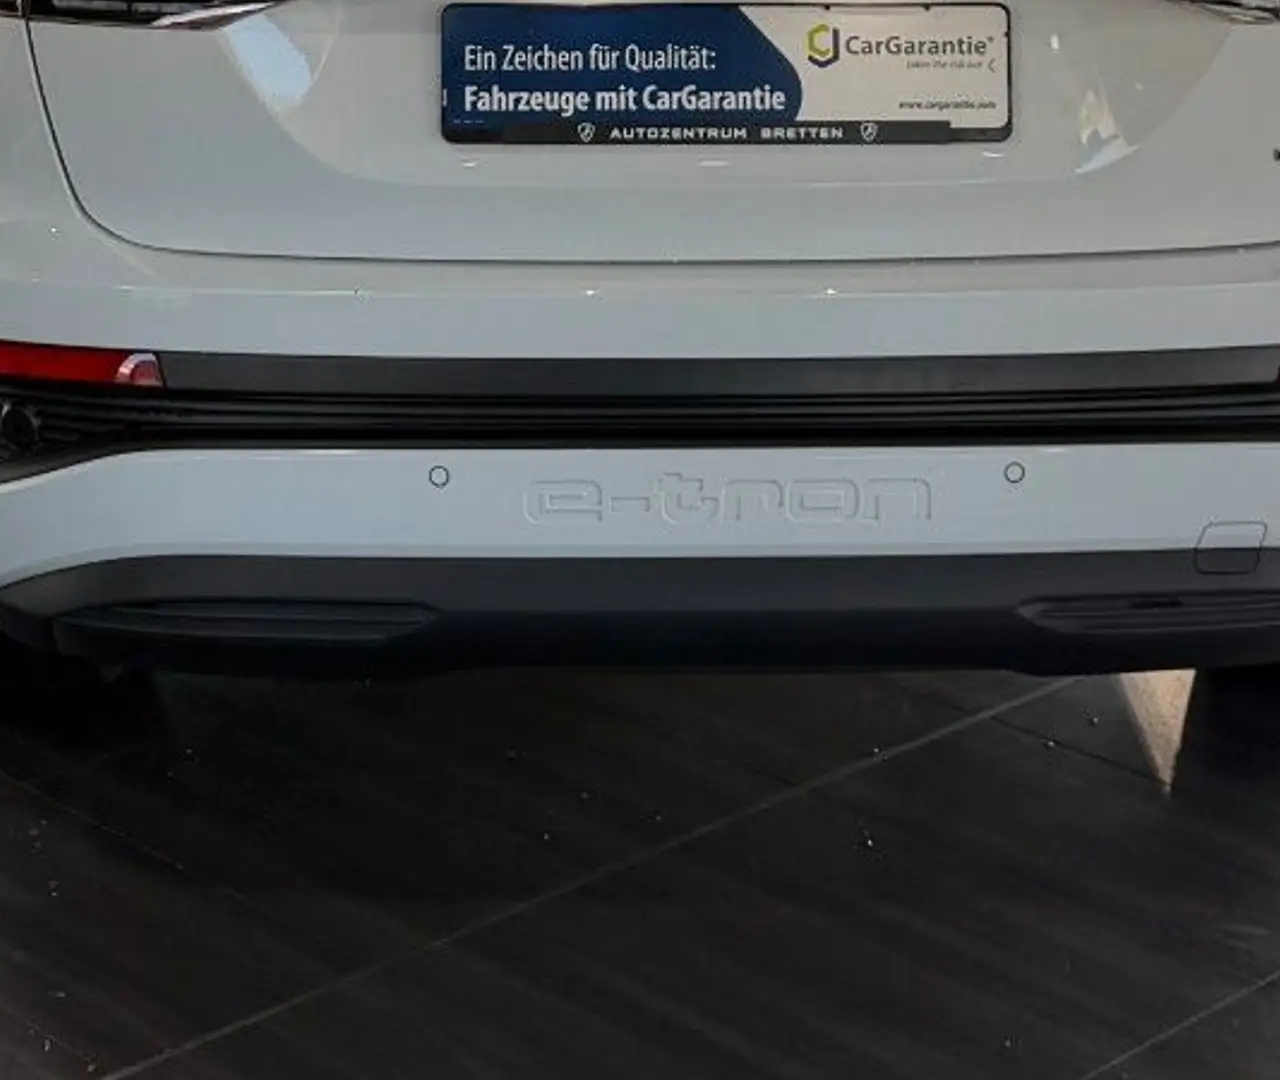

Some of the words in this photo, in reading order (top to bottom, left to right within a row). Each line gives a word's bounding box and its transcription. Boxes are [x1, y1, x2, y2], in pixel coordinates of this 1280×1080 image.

[463, 44, 496, 71] Ein
[501, 44, 584, 71] Zeichen
[588, 42, 620, 71] für
[624, 43, 717, 73] Qualität:
[463, 85, 591, 117] Fahrzeuge
[595, 85, 638, 112] mit
[641, 84, 787, 112] CarGarantie
[609, 126, 749, 140] AUTOZENTRUM
[760, 126, 844, 140] BRETTEN
[522, 471, 934, 524] e-tron
